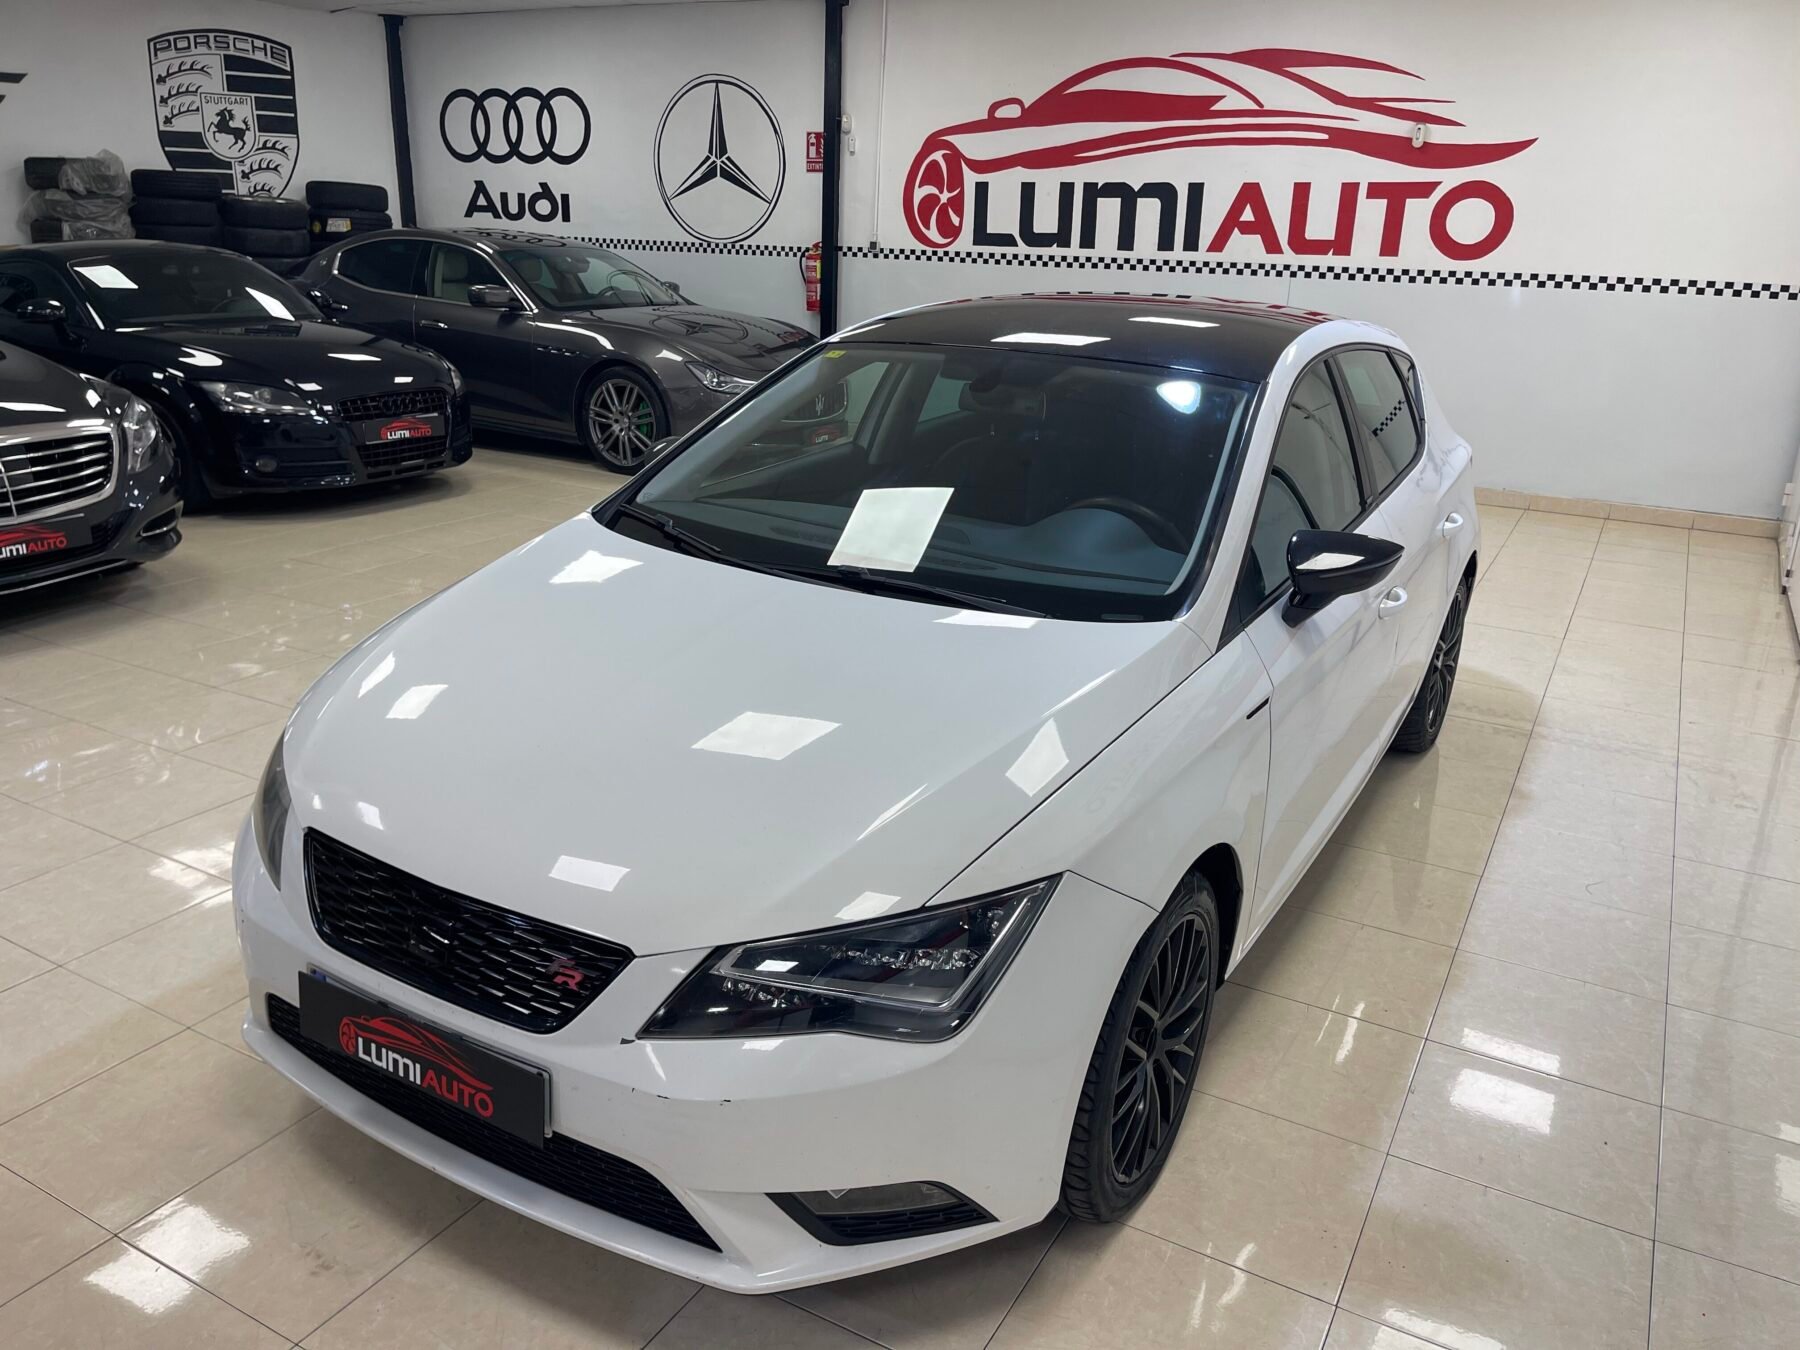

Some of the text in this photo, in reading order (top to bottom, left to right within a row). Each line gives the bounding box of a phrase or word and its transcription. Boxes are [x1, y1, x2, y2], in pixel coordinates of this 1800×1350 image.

[153, 34, 289, 68] PORSCHE
[203, 95, 249, 106] STUTTGART
[463, 180, 571, 223] Audi
